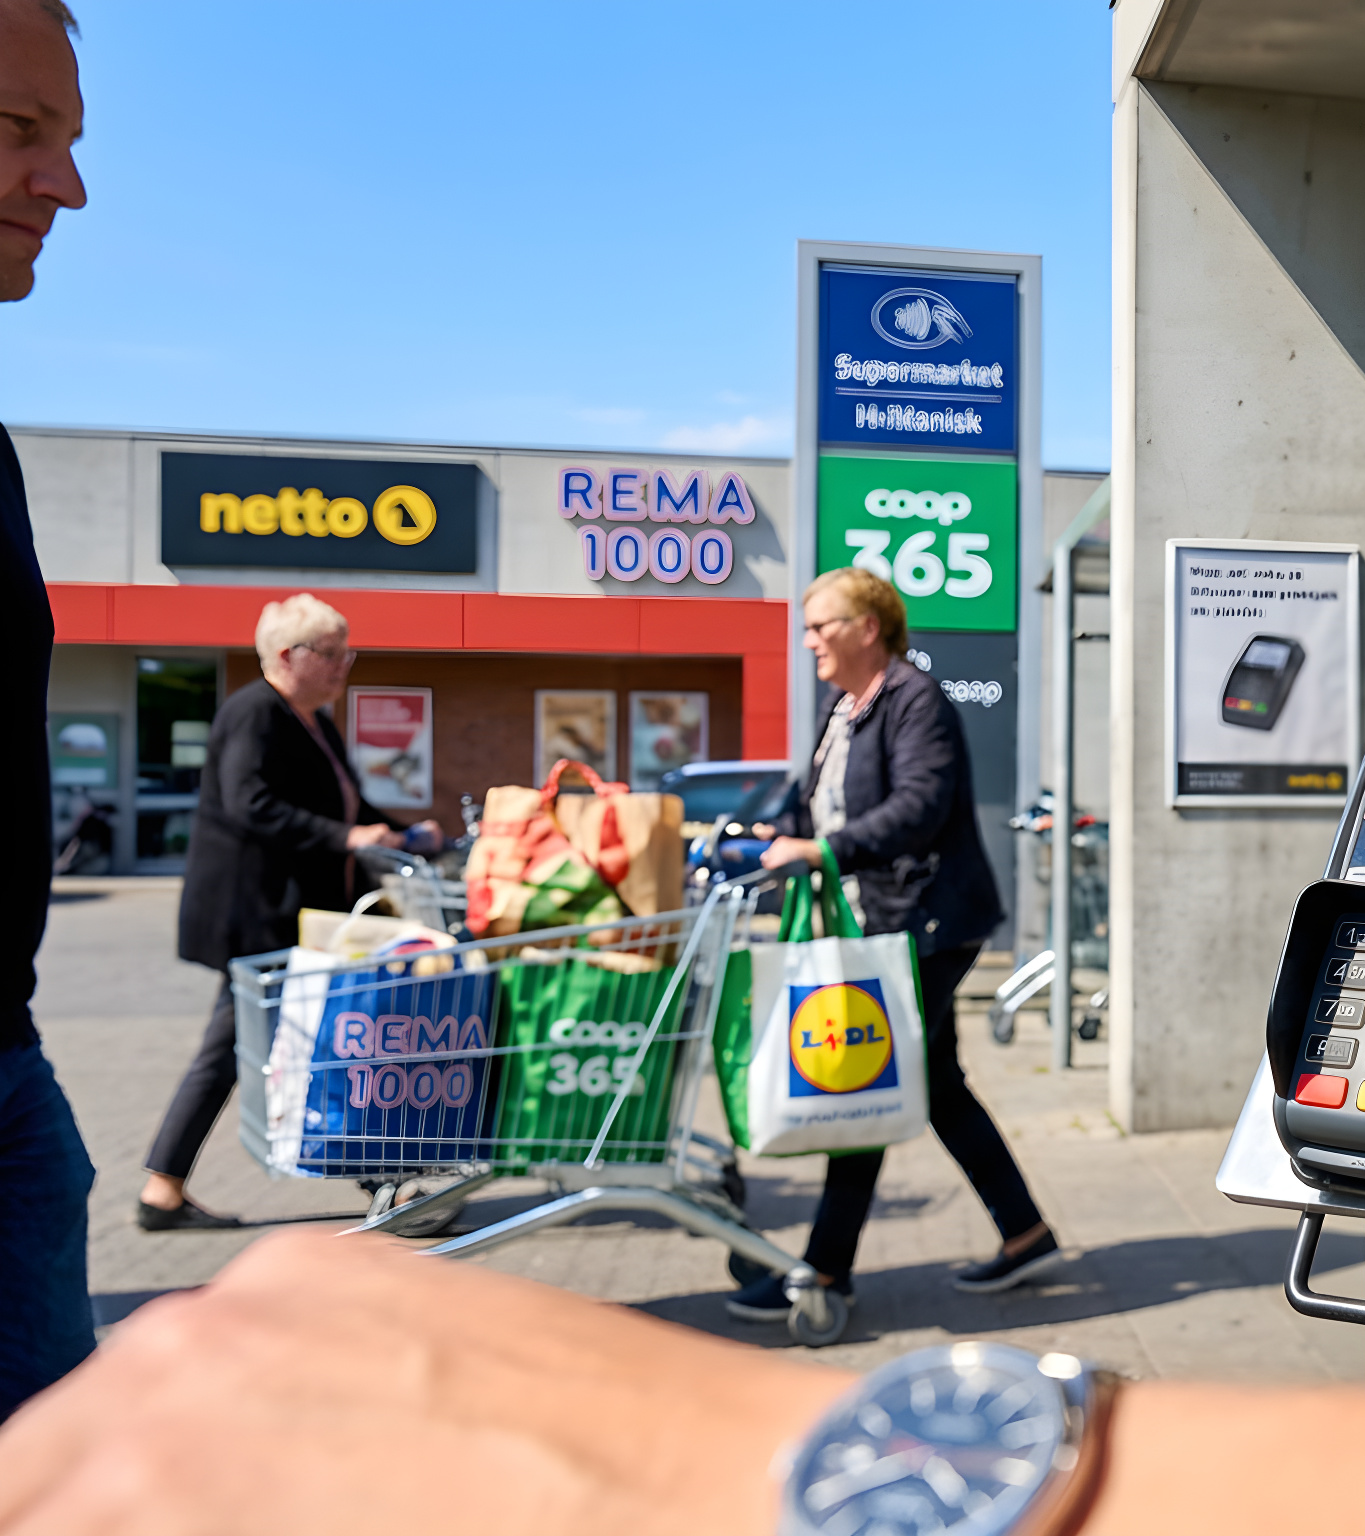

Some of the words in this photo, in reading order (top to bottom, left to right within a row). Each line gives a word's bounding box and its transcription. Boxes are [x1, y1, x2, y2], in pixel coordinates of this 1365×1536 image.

[200, 487, 368, 537] netto
[558, 466, 756, 524] REMA
[865, 488, 972, 526] coop
[578, 525, 733, 585] 1000
[845, 530, 993, 598] 365
[333, 1011, 488, 1058] REMA
[347, 1063, 474, 1110] 1000
